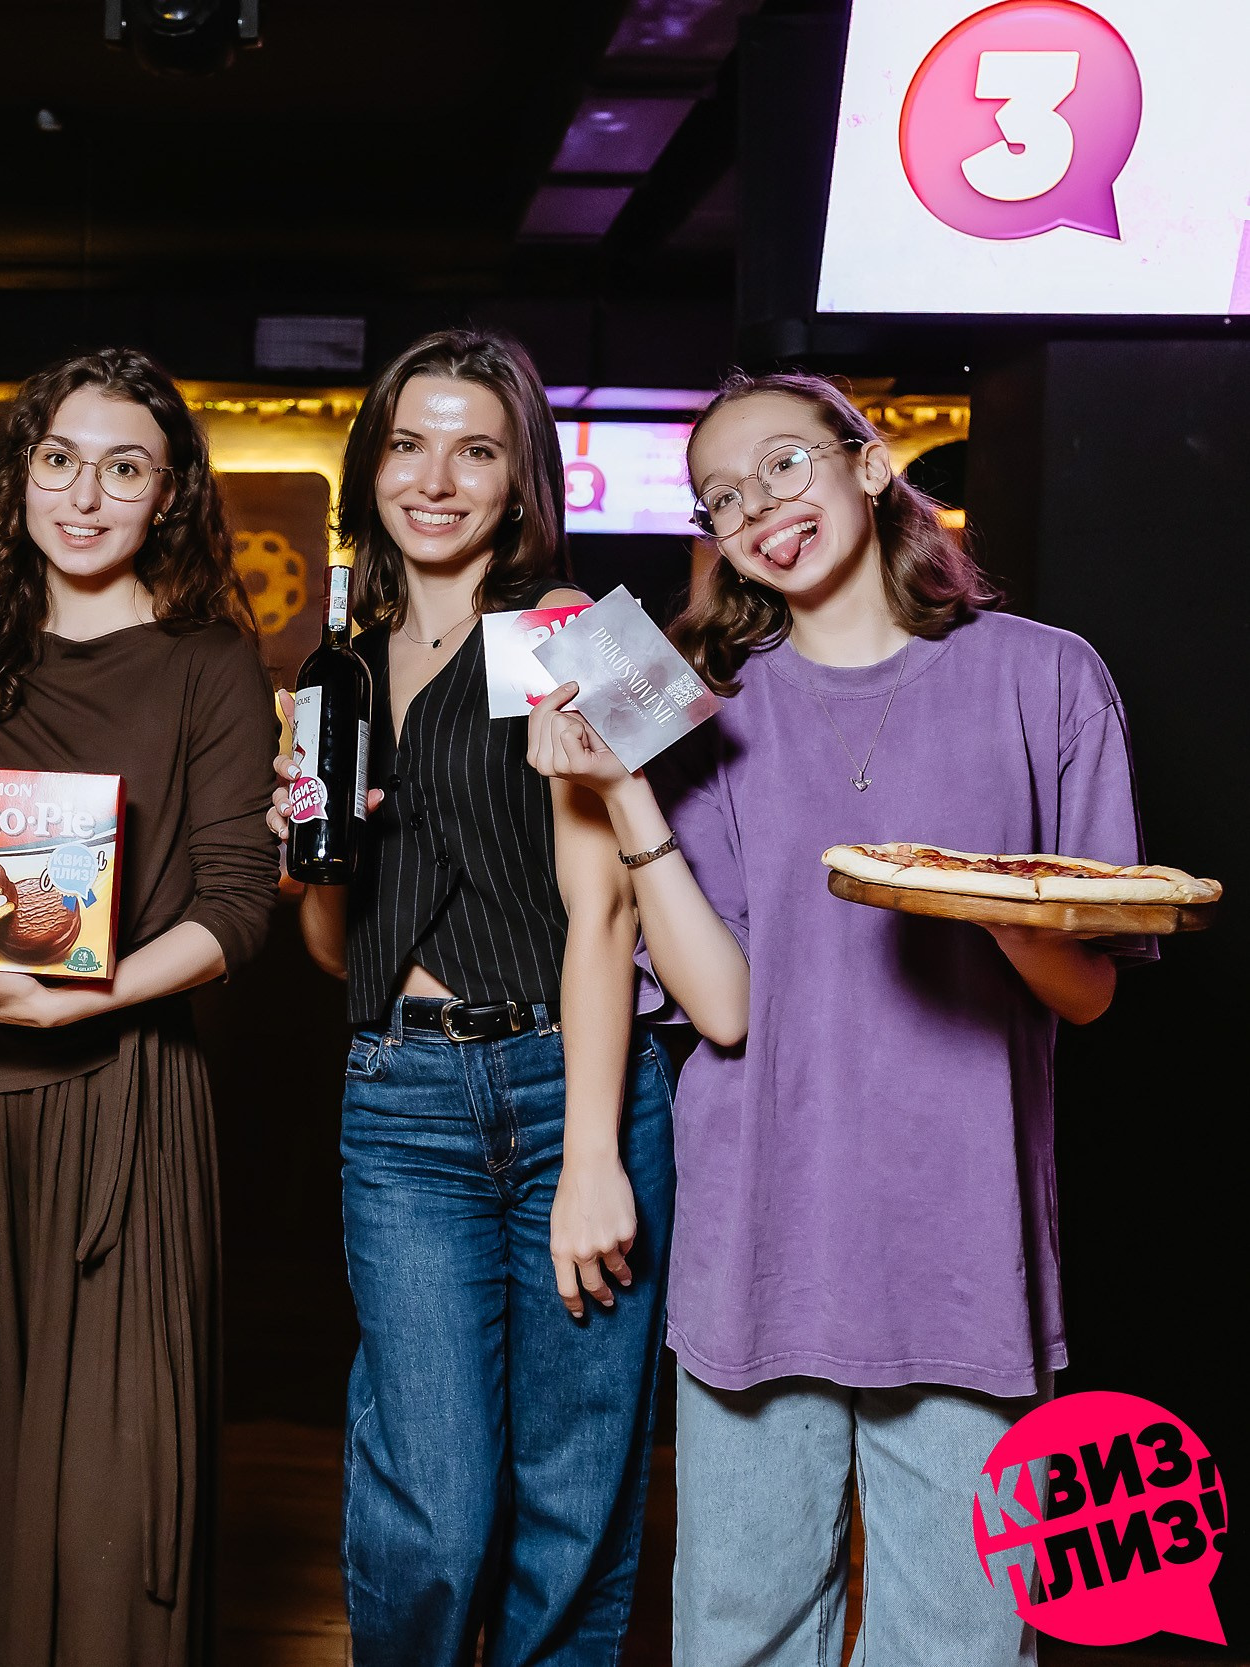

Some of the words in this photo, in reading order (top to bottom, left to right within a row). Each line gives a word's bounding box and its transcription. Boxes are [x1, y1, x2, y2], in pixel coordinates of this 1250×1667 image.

[960, 50, 1081, 202] 3
[566, 470, 595, 507] 3
[297, 696, 311, 706] OUSE
[589, 626, 677, 728] PRIKOSNOVENIE
